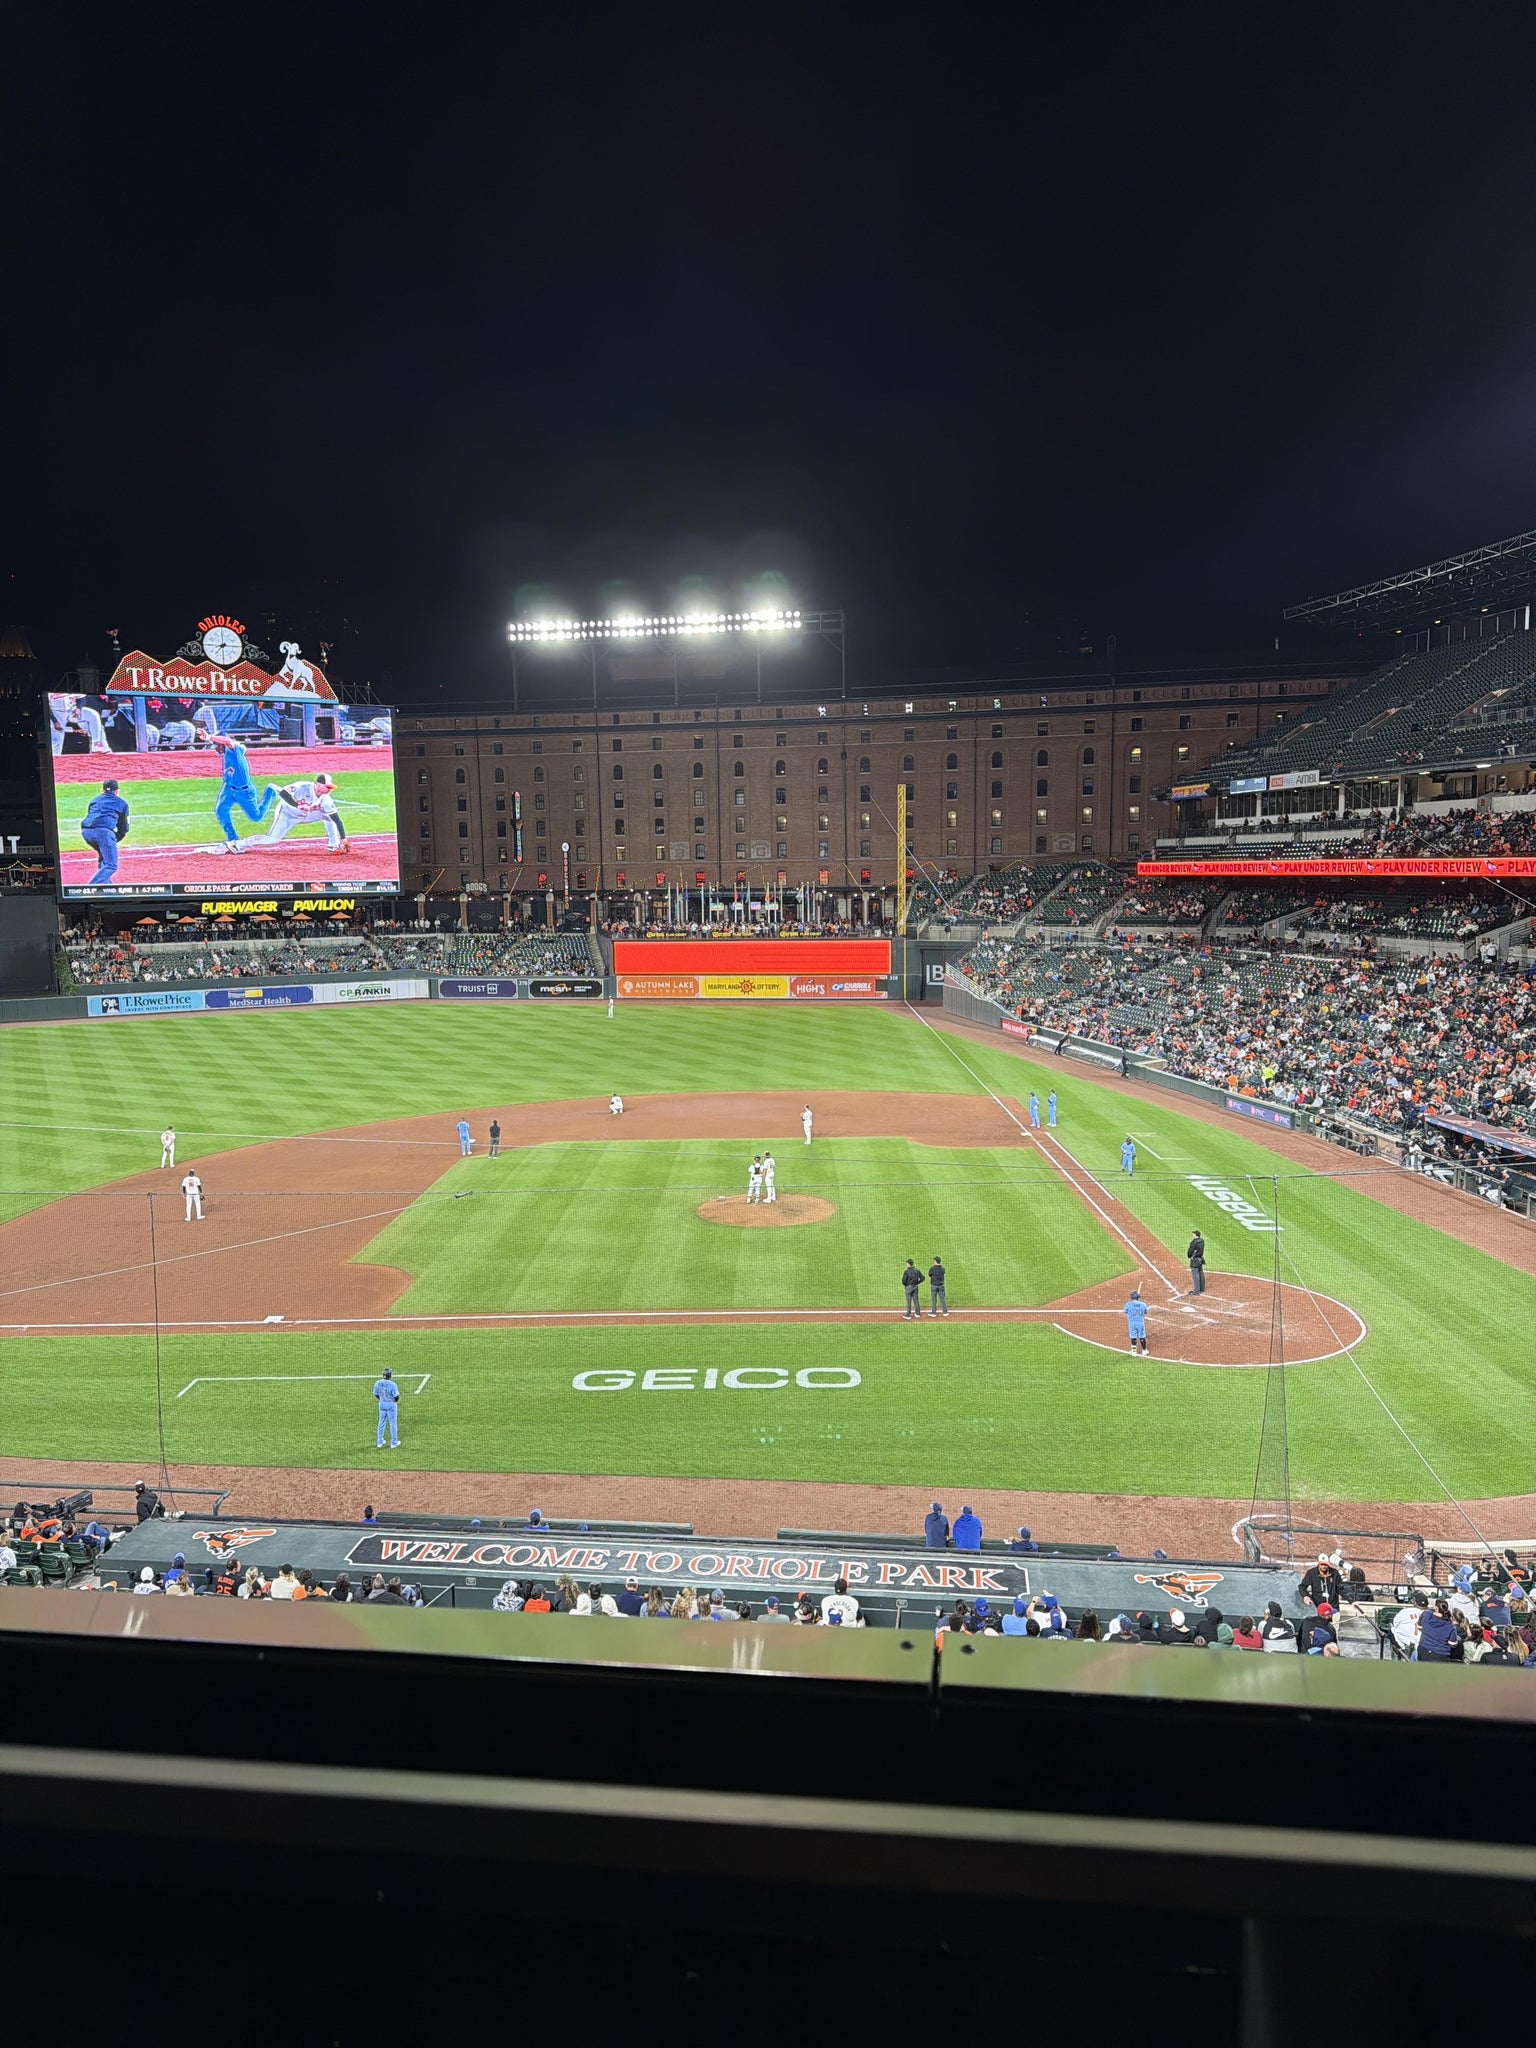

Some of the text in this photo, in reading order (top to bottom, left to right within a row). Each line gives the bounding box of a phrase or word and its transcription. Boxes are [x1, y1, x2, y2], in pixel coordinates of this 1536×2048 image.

[197, 615, 246, 635] ORIOLES
[209, 671, 261, 693] Price
[1139, 864, 1191, 873] PLAY UNDER REVIEW
[1204, 863, 1268, 872] PLAY UNDER REVIEW
[1284, 862, 1363, 872] PLAY UNDER REVIEW
[1383, 862, 1481, 872] PLAY UNDER REVIEW
[1508, 861, 1536, 872] PLAY
[184, 885, 211, 893] ORIOLE
[212, 884, 231, 892] PARK
[239, 884, 270, 892] CAMDEN
[465, 882, 488, 892] BOOG'S
[201, 899, 355, 915] PUREWAGER PAVILION
[457, 985, 486, 993] TRUIST
[635, 981, 694, 989] AUTUMN LAKE
[796, 984, 825, 995] HIGH'S
[165, 994, 191, 1005] Price
[229, 997, 292, 1007] MedStar Health
[572, 1367, 861, 1391] GEICO
[381, 1539, 1009, 1592] WELCOME TO ORIOLE PARK
[216, 1584, 232, 1595] 25
